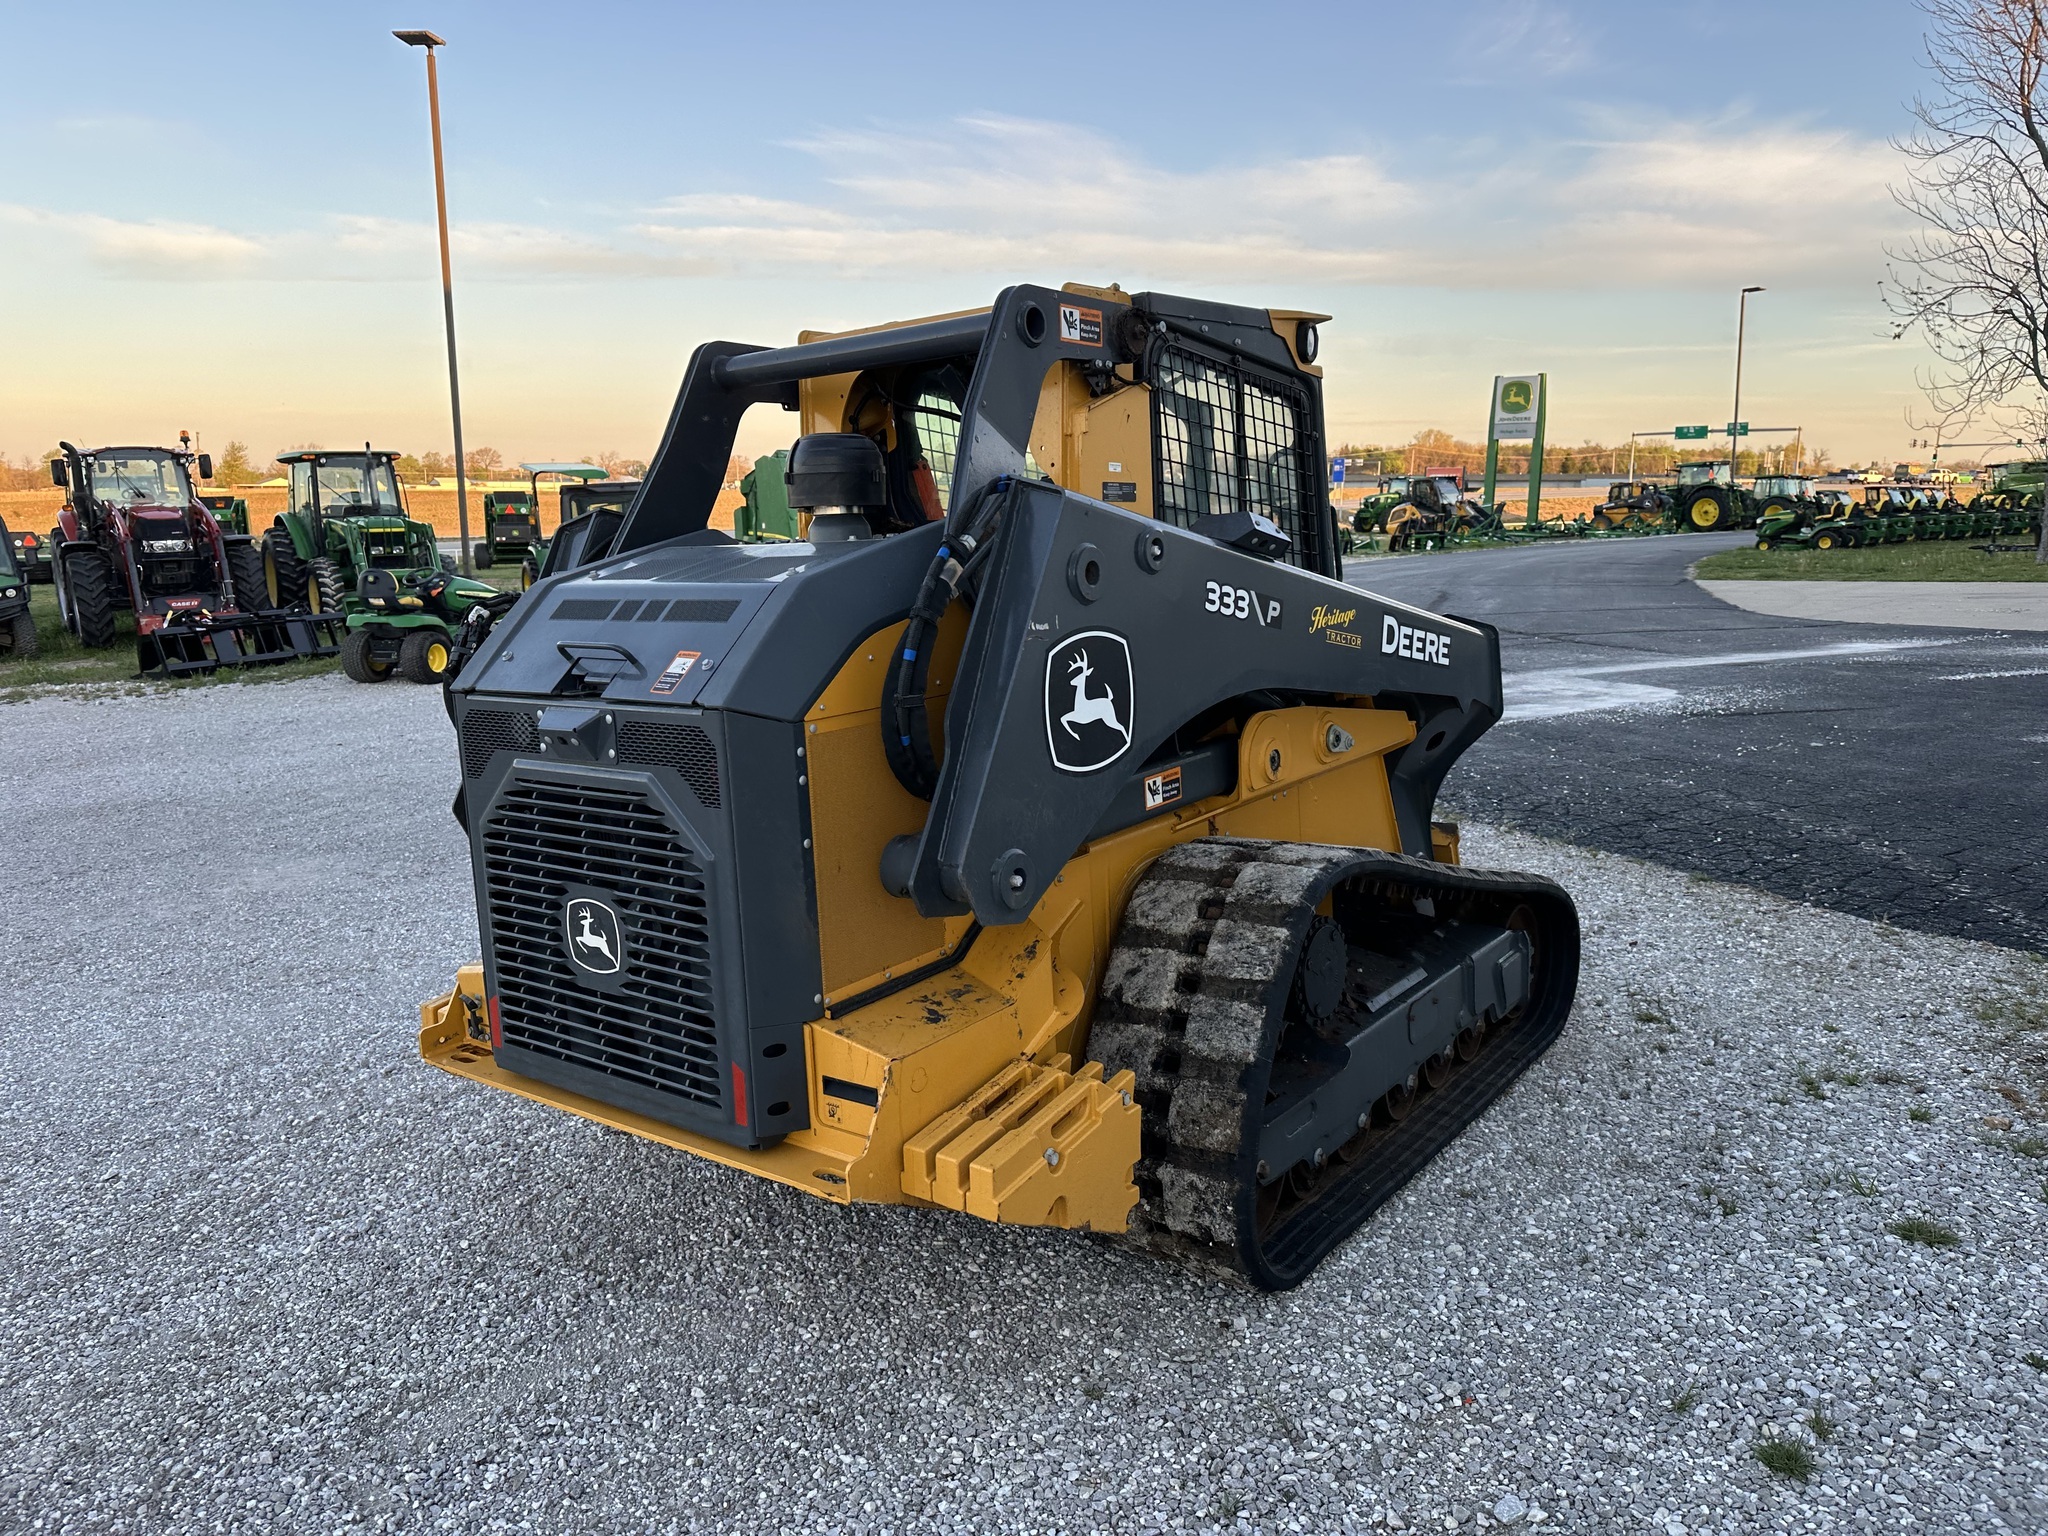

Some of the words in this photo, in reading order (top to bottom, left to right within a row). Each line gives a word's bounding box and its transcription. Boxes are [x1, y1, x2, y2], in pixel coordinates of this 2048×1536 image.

[1308, 604, 1357, 634] Heritage
[1326, 631, 1362, 647] TRACTOR
[1381, 614, 1451, 666] DEERE
